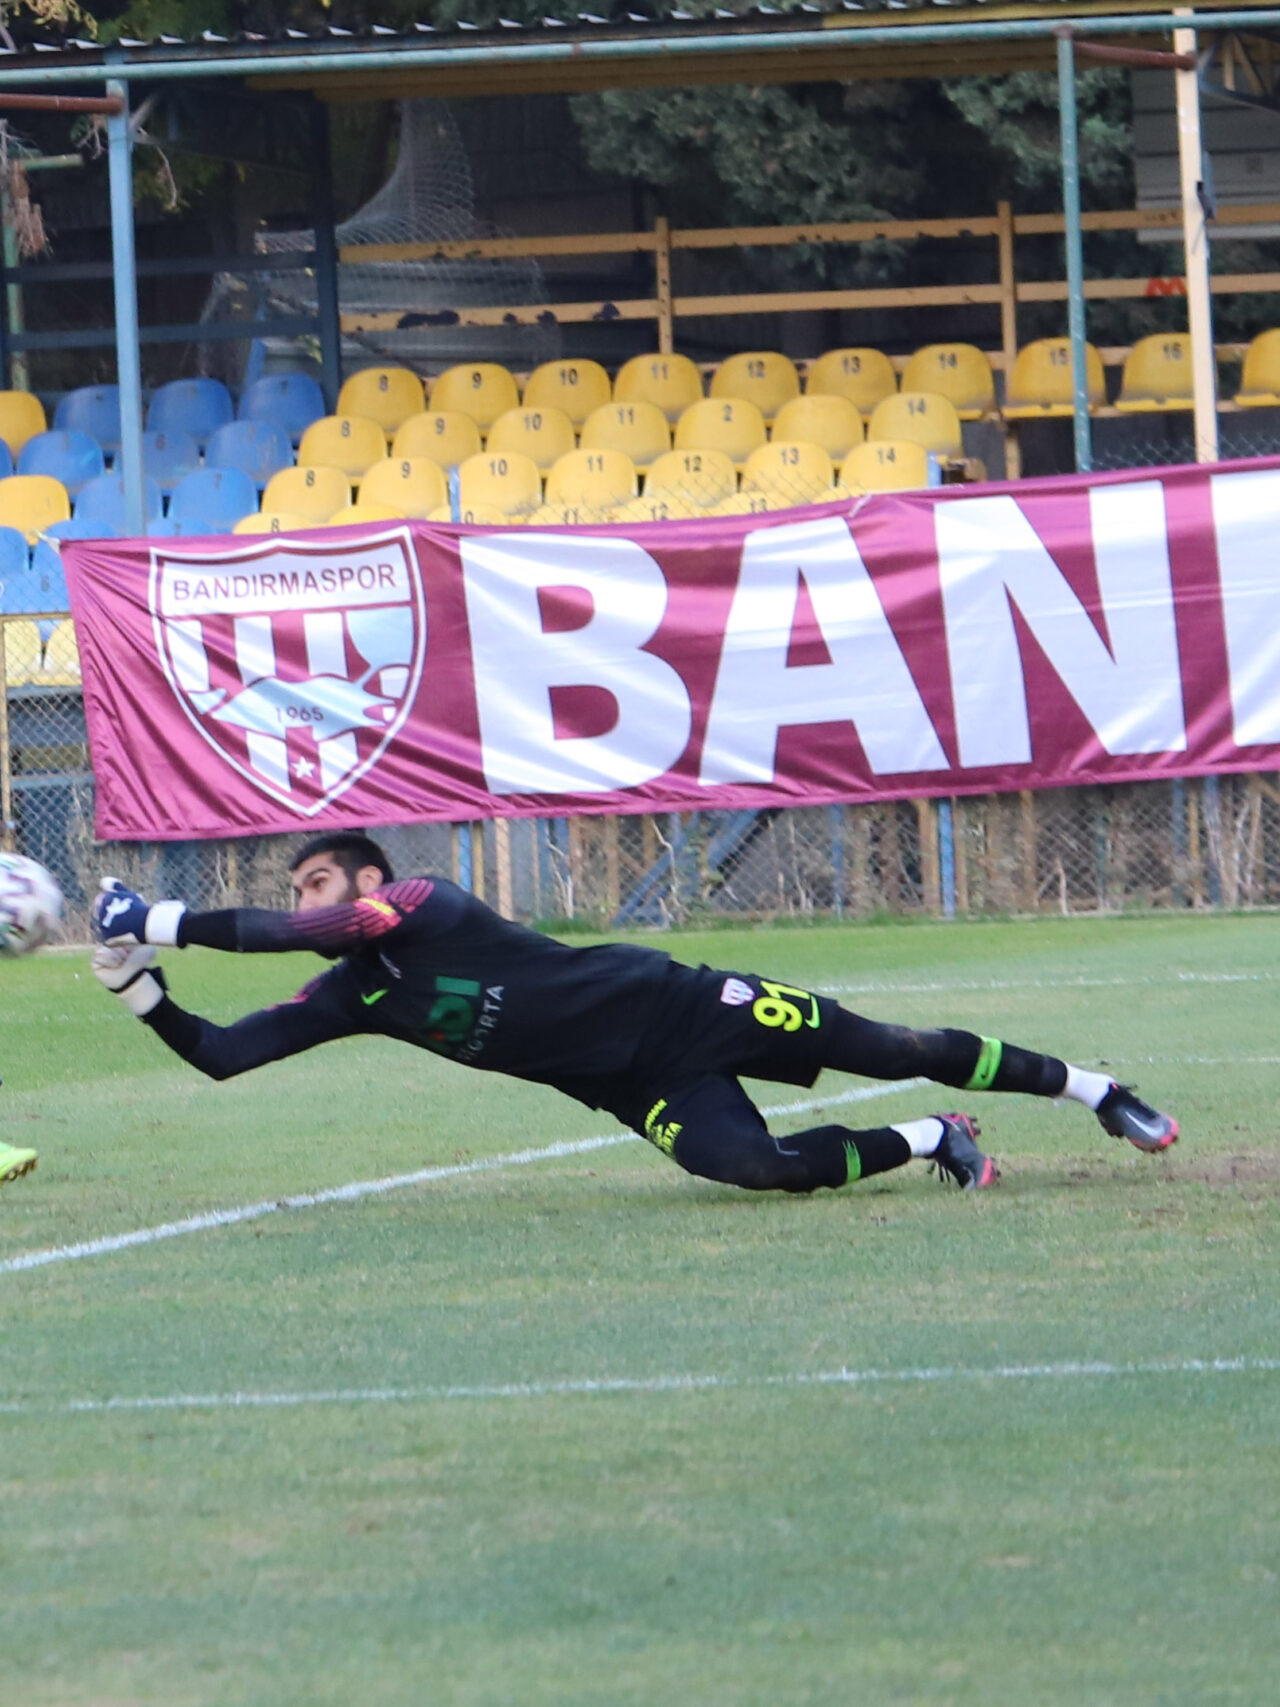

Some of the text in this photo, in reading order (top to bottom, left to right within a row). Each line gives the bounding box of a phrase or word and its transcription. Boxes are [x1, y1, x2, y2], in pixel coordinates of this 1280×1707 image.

[1049, 347, 1068, 366] 15
[1162, 342, 1182, 360] 16
[746, 361, 766, 378] 12
[842, 356, 861, 374] 13
[938, 352, 957, 370] 14
[472, 371, 483, 389] 9
[560, 368, 578, 386] 10
[651, 363, 669, 380] 11
[378, 374, 389, 392] 8
[723, 404, 733, 422] 2
[907, 398, 927, 416] 14
[524, 413, 542, 431] 10
[617, 408, 635, 425] 11
[341, 420, 351, 438] 8
[435, 418, 445, 435] 9
[587, 455, 604, 472] 11
[684, 456, 702, 473] 12
[781, 448, 800, 465] 13
[877, 448, 896, 464] 14
[401, 461, 411, 479] 9
[489, 458, 508, 476] 10
[306, 469, 316, 487] 8
[173, 563, 397, 601] BANDIRMASPOR
[275, 705, 324, 725] 1965
[752, 979, 811, 1033] 91
